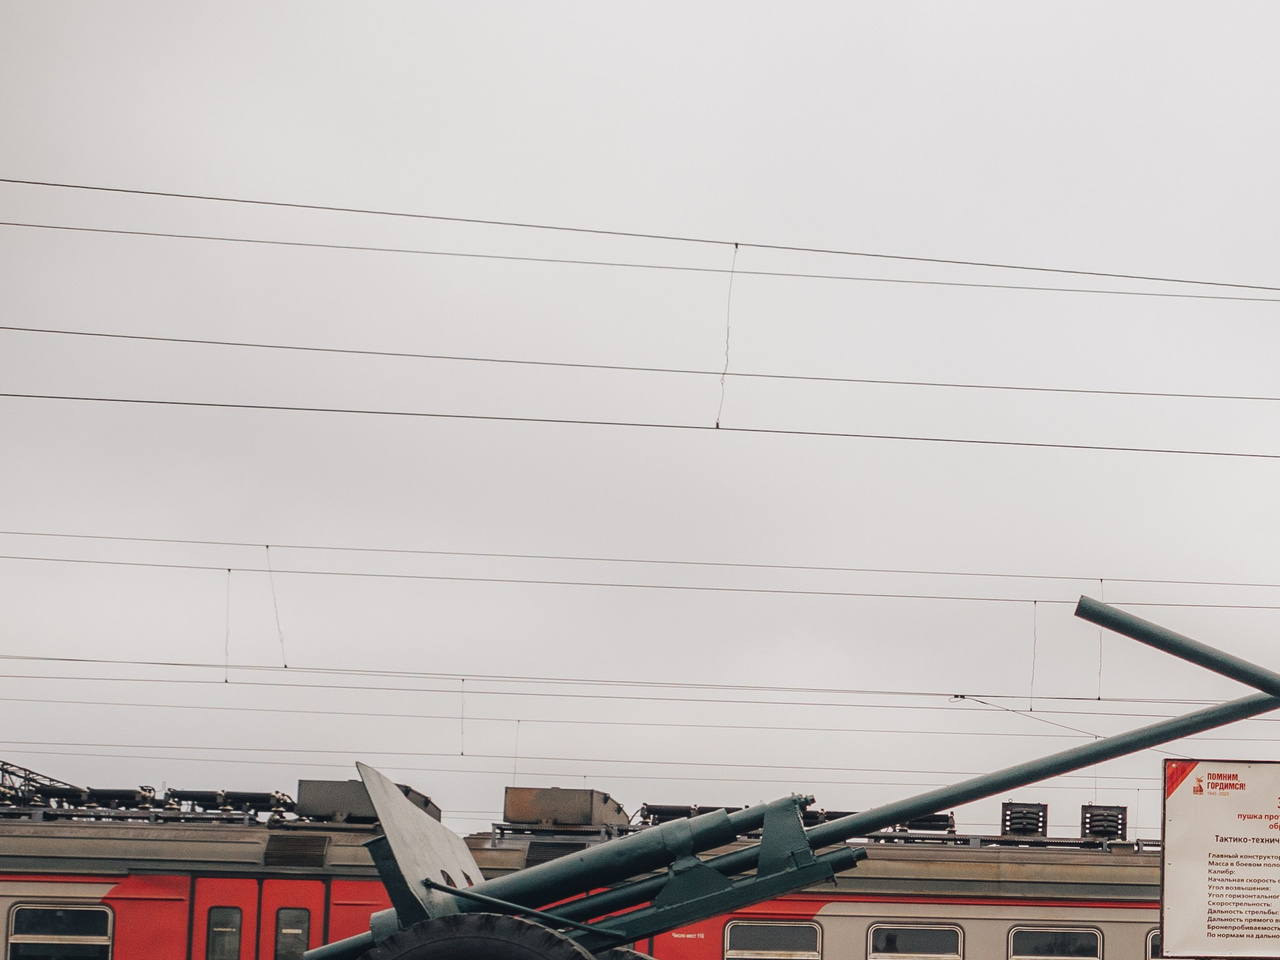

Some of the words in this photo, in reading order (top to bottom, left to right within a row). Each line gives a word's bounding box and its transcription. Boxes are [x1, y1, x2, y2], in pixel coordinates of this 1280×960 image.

[1207, 773, 1240, 782] ПОМНИМ,
[1207, 782, 1246, 791] ГОРДИМСЯ!
[1237, 813, 1263, 821] пушка
